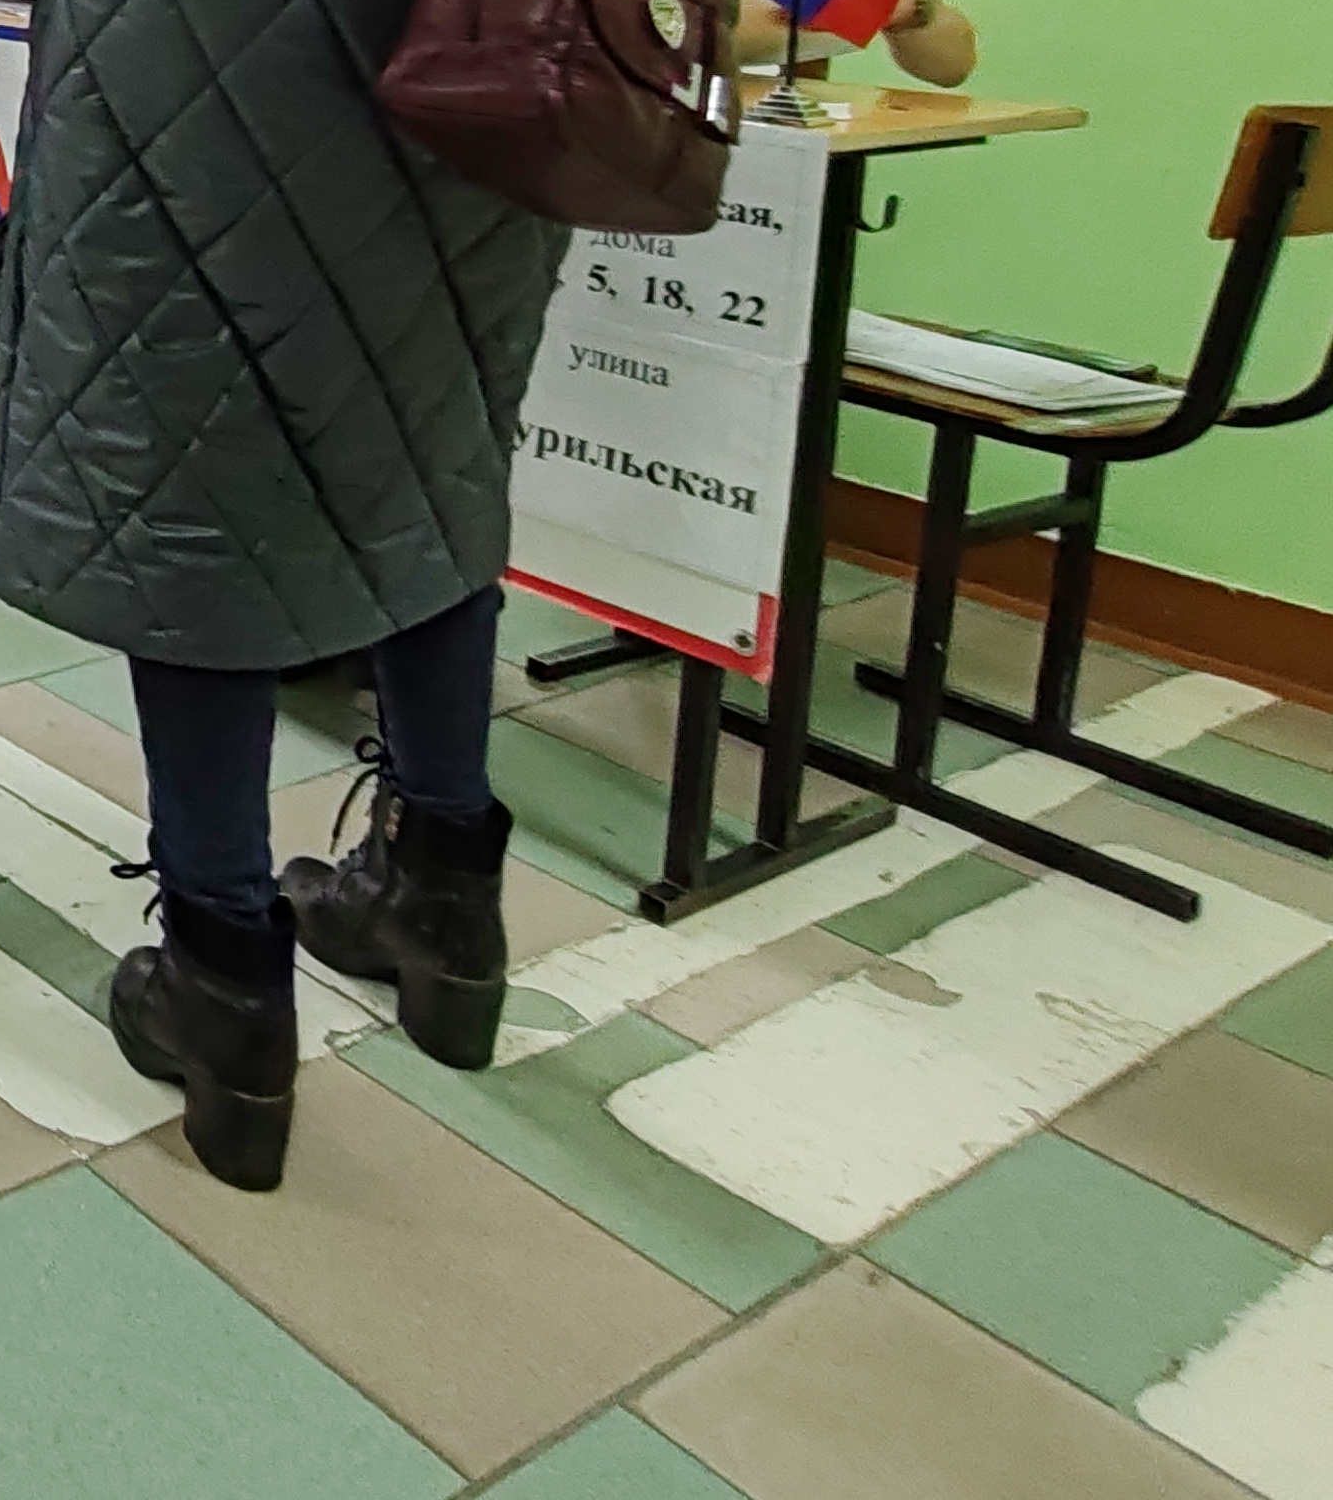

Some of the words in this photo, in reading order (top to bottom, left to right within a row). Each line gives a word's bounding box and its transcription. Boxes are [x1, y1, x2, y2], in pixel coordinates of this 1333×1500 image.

[590, 230, 676, 258] дома
[643, 276, 694, 316] 18,
[718, 291, 767, 328] 22
[568, 344, 670, 388] улица
[513, 421, 758, 516] урильская
